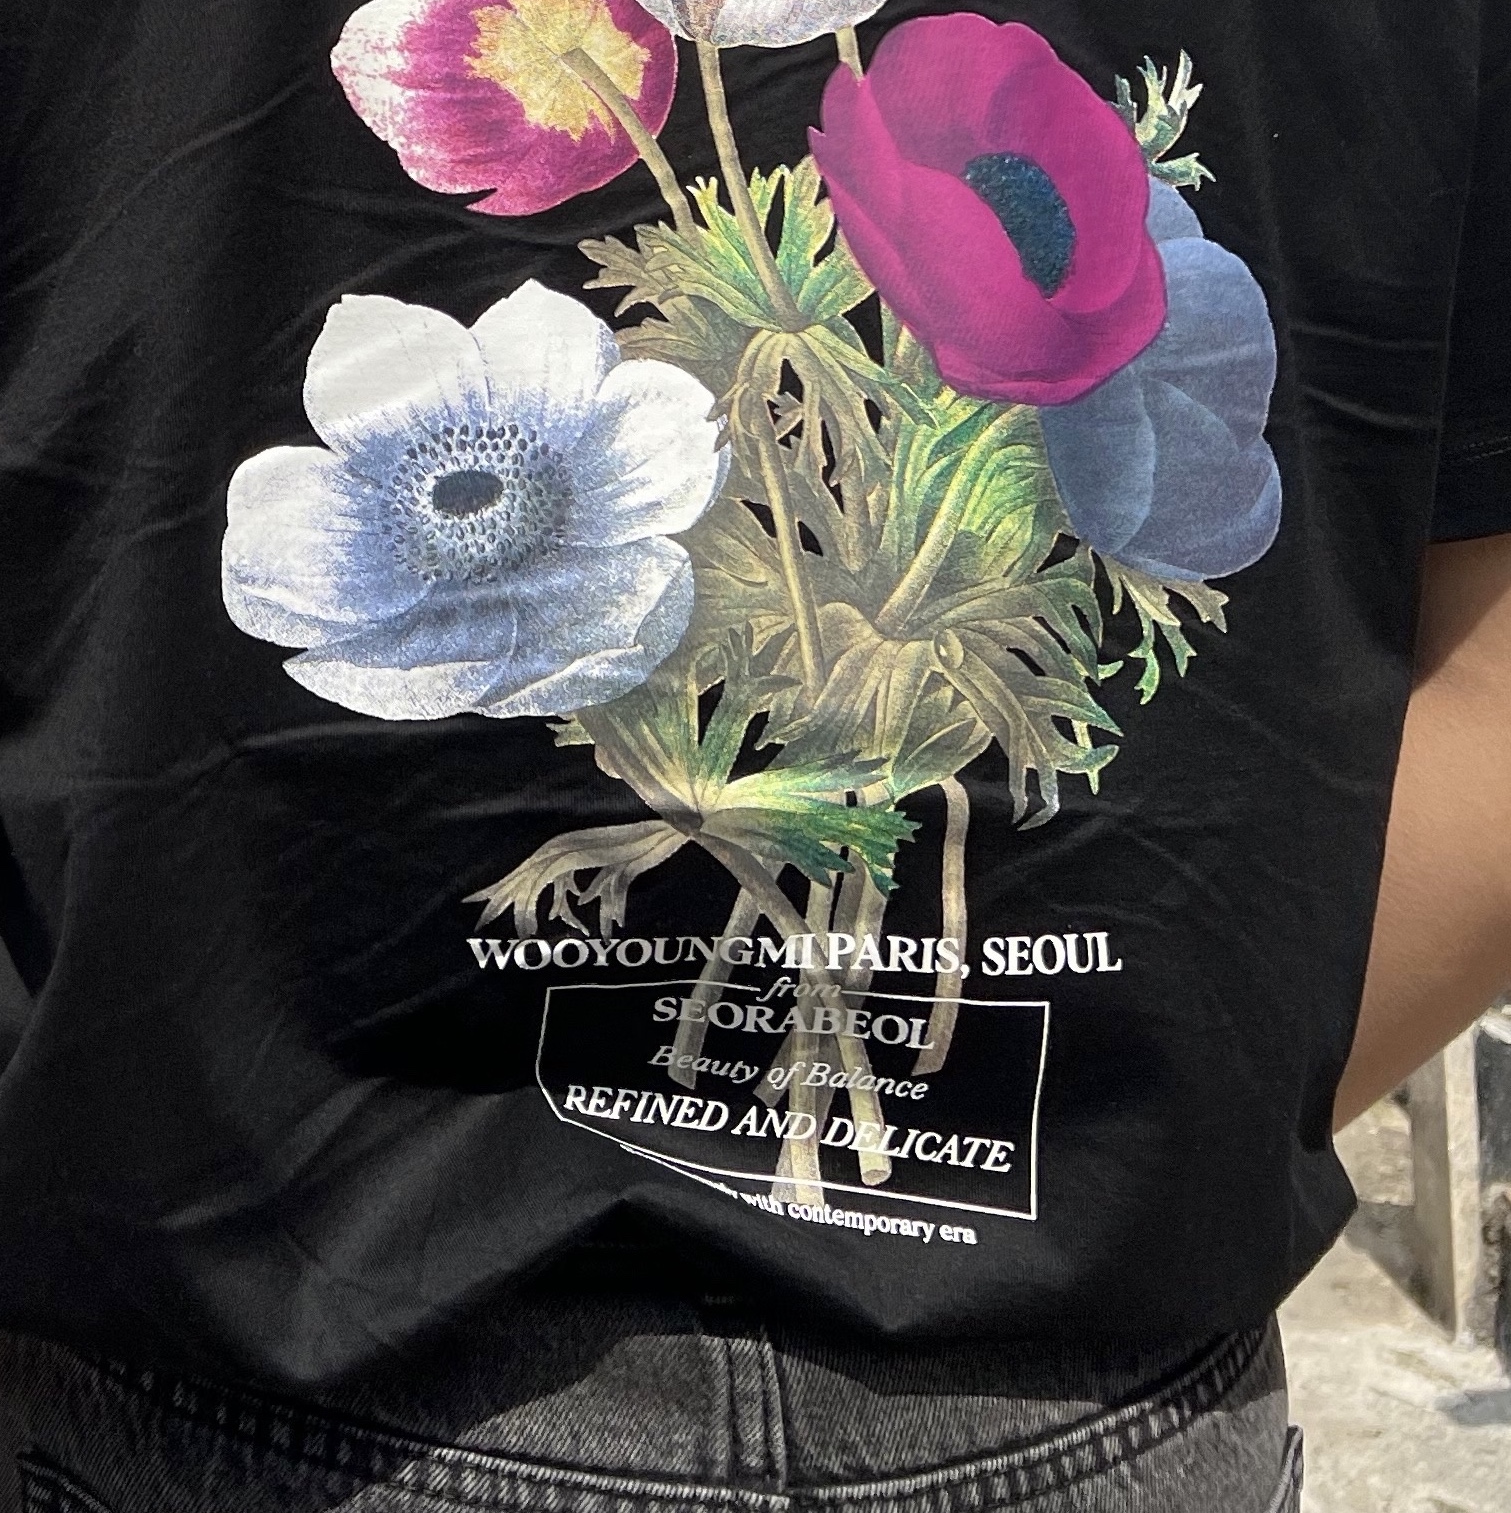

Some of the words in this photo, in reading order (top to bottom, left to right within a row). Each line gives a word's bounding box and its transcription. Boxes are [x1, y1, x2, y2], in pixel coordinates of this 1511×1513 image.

[466, 933, 816, 970] WOOYOUNGMI
[826, 932, 970, 979] PARIS,
[982, 931, 1122, 976] SEOUL
[756, 976, 842, 1001] from
[652, 996, 935, 1049] SEORABEOL
[647, 1045, 760, 1084] Beauty
[766, 1061, 806, 1090] of
[800, 1062, 929, 1100] Balance
[563, 1084, 730, 1131] REFINED
[731, 1105, 817, 1140] AND
[820, 1116, 1015, 1173] DELICATE
[740, 1192, 785, 1216] with
[787, 1202, 936, 1244] contemporary
[938, 1223, 978, 1245] era
